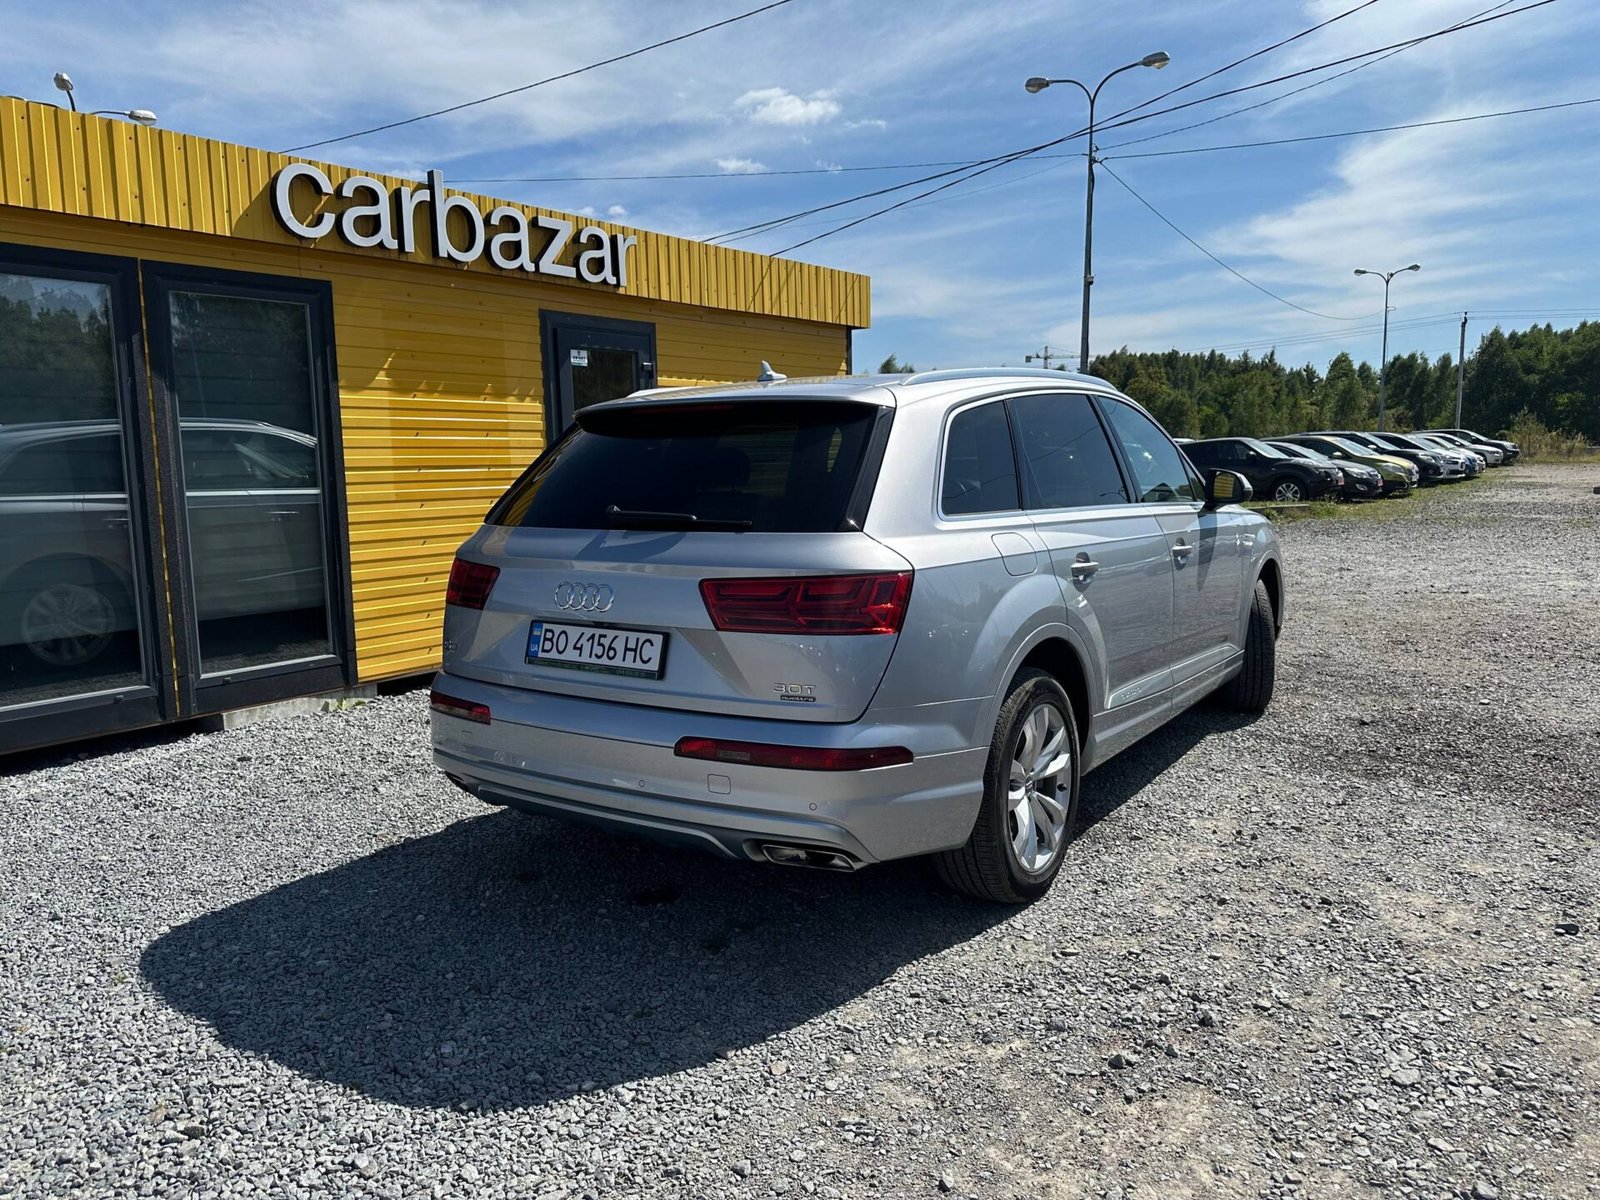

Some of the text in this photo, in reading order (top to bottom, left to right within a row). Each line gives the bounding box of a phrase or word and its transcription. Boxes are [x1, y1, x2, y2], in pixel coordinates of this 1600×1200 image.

[271, 163, 637, 287] carbazar
[541, 628, 654, 665] BO 4156 HC
